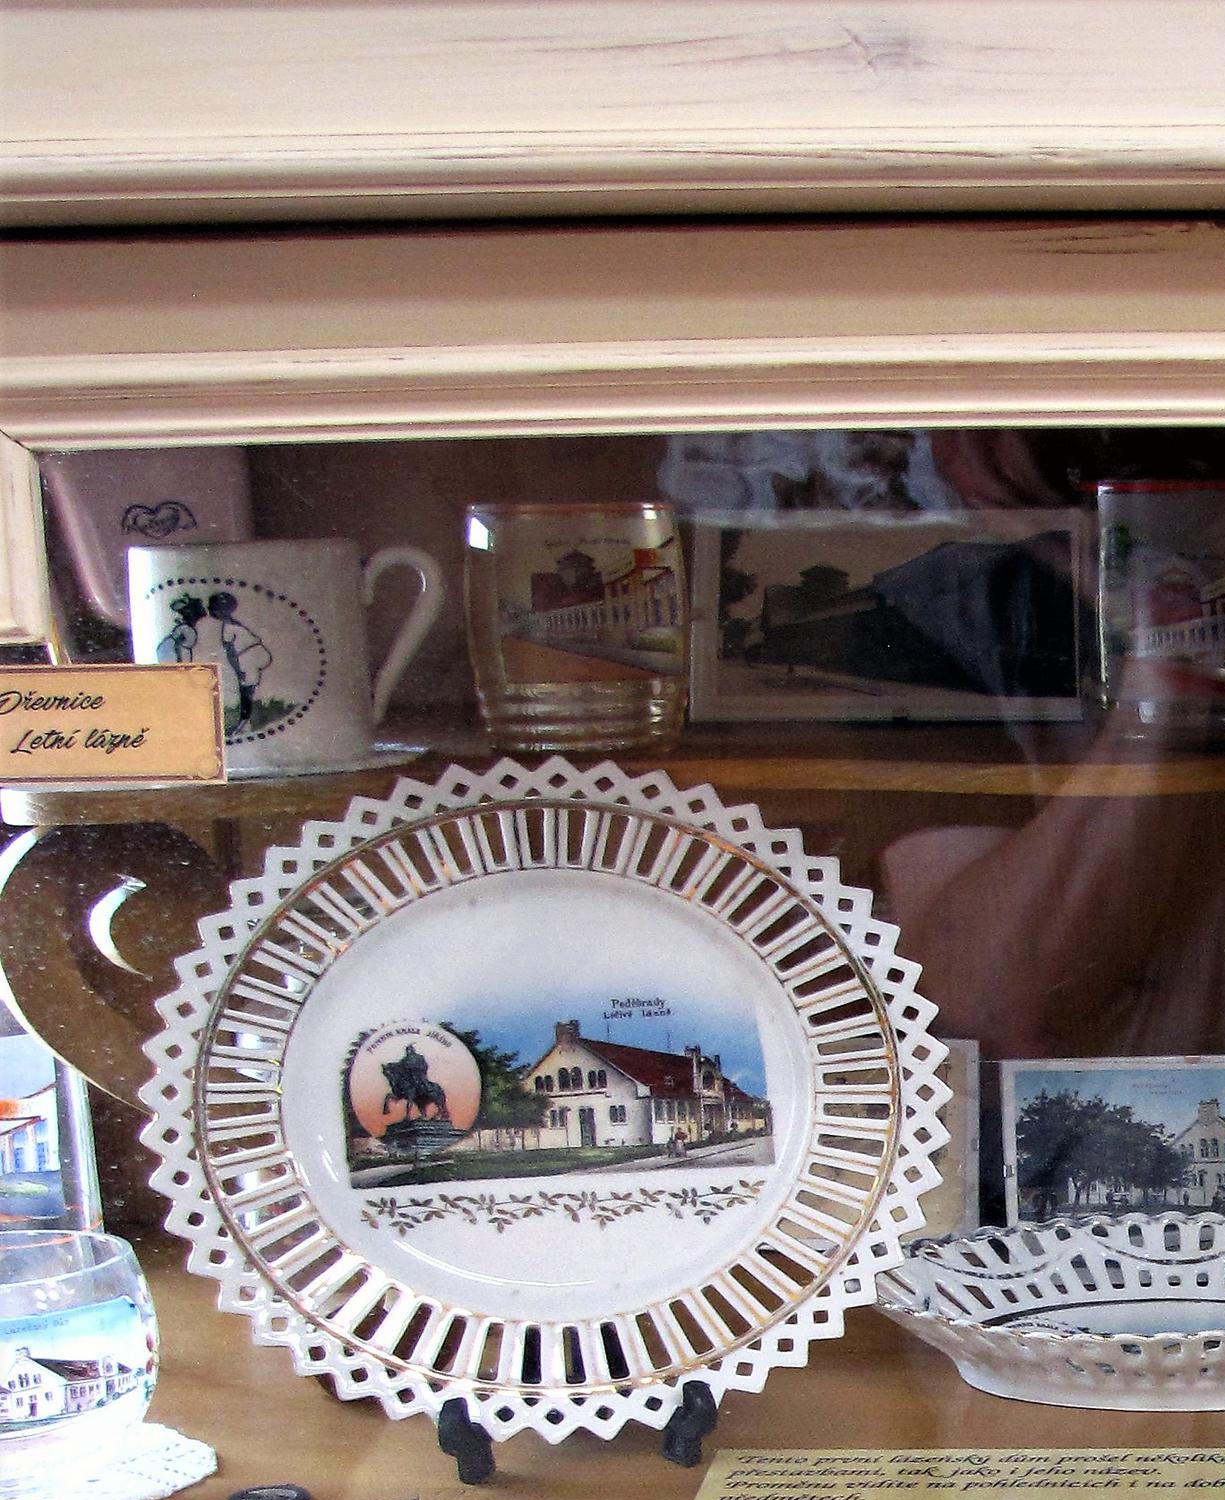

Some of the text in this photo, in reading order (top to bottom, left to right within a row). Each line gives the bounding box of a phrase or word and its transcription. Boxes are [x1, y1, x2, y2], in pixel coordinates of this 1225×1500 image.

[10, 726, 150, 754] Letní lázně
[738, 1455, 808, 1464] Tento
[812, 1455, 883, 1466] první
[1054, 1453, 1133, 1465] prošel
[898, 1466, 944, 1477] tak
[945, 1466, 1001, 1478] jako
[1018, 1466, 1075, 1477] jeho
[1083, 1466, 1161, 1476] název.
[725, 1480, 837, 1489] Proměnu
[926, 1481, 956, 1489] na
[1146, 1480, 1176, 1488] na
